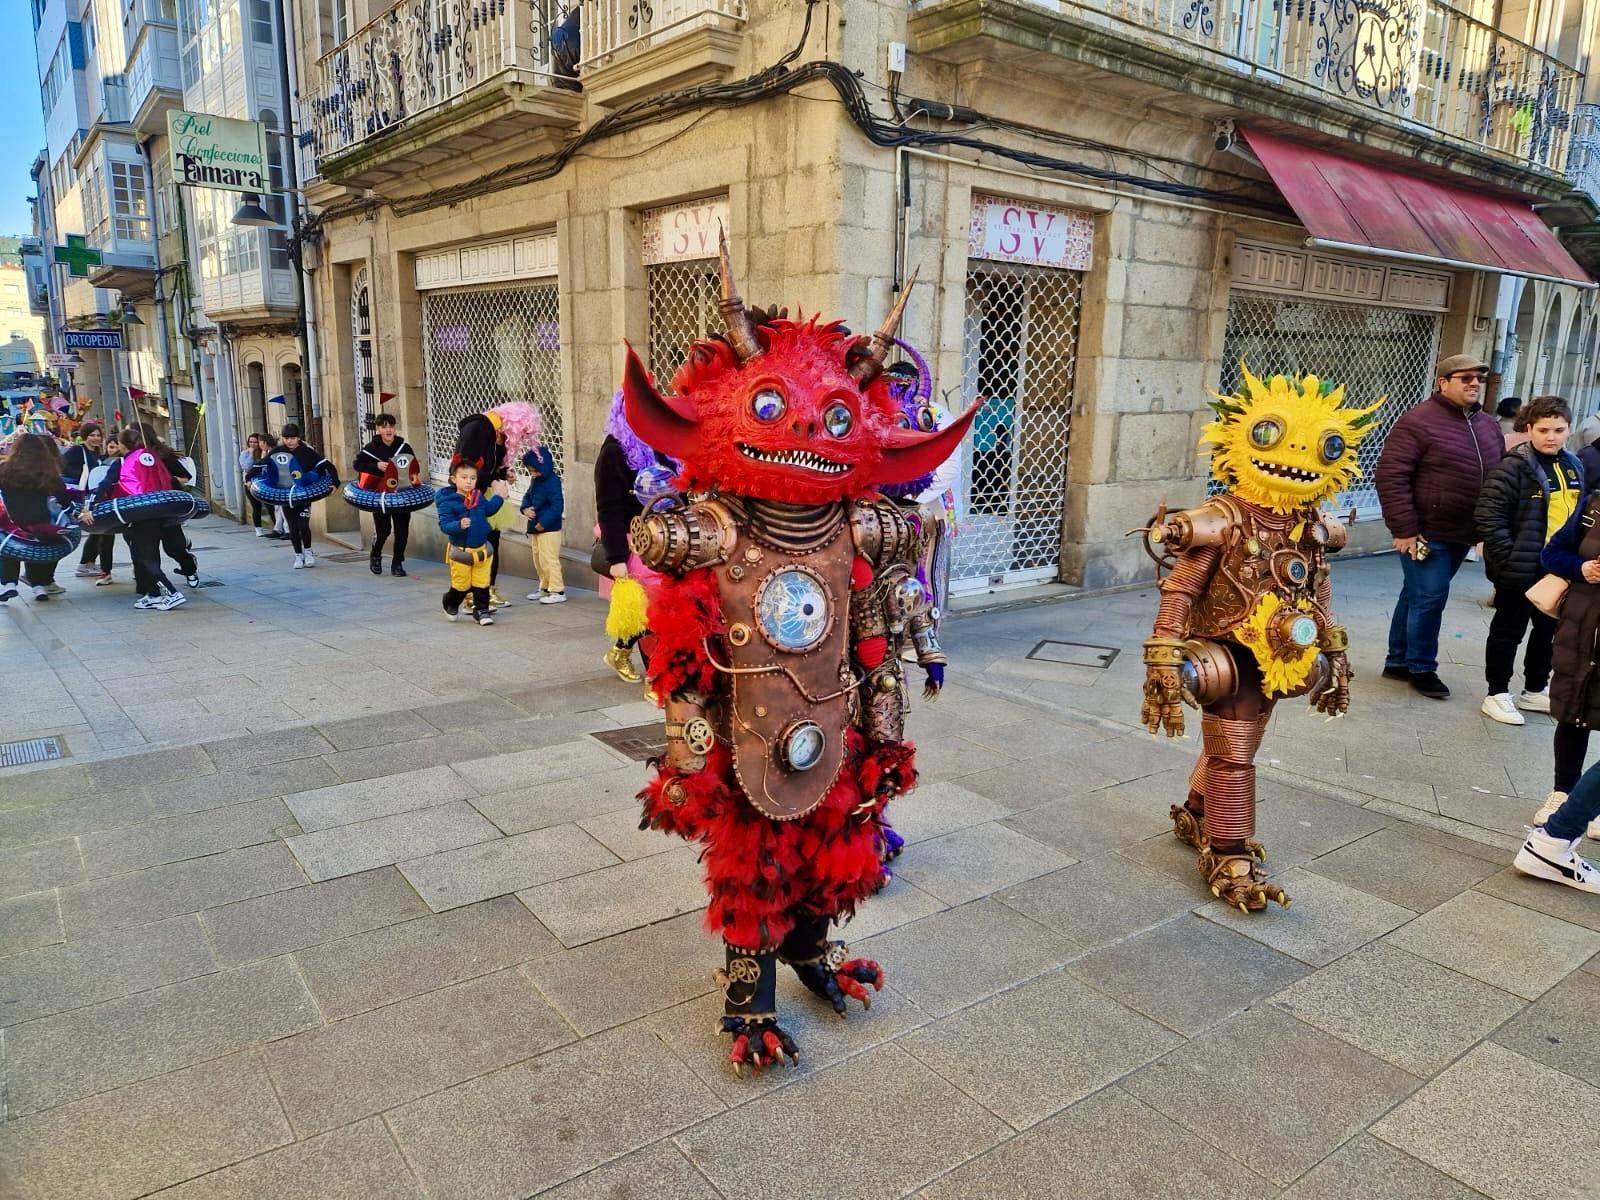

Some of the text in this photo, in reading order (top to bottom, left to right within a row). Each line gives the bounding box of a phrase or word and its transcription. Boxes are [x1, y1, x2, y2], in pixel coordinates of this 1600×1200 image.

[173, 113, 212, 135] Piel
[179, 135, 263, 165] Confecciones
[176, 153, 262, 188] Tamara
[674, 205, 715, 254] SV
[999, 207, 1056, 257] SV
[66, 334, 120, 347] ORTOPEDIA
